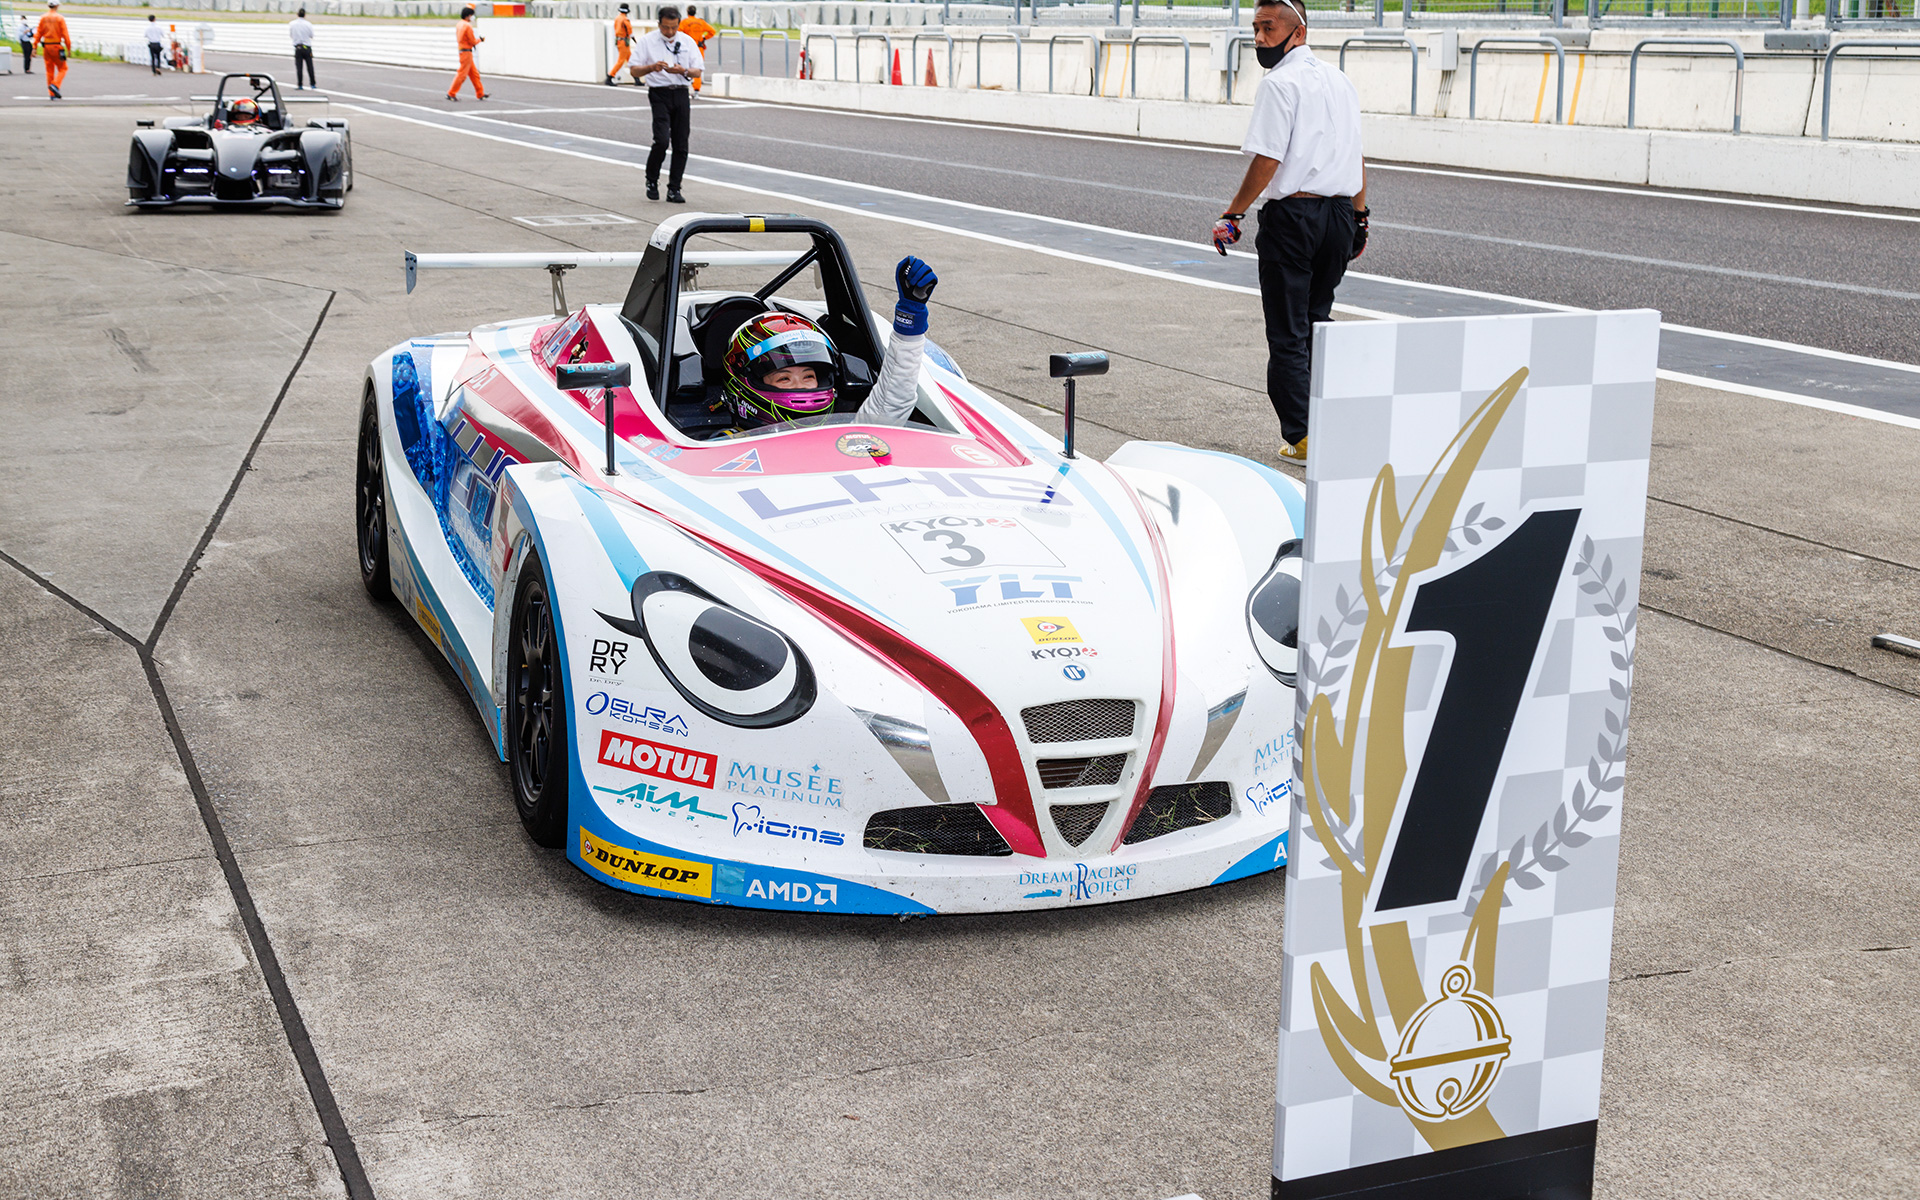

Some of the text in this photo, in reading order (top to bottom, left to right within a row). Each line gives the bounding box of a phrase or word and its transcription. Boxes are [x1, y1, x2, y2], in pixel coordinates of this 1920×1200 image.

[737, 471, 1074, 520] LHG
[922, 529, 986, 567] 3
[940, 574, 1083, 606] YLT
[947, 604, 992, 614] YOKOHAMA
[592, 639, 629, 659] DR
[589, 656, 627, 675] RY
[1374, 508, 1583, 912] 1
[602, 737, 711, 783] MOTUL
[1254, 728, 1295, 764] MUS
[727, 780, 841, 808] PLATINUM
[616, 798, 695, 822] POWER
[595, 847, 699, 884] DUNLOP
[1019, 863, 1137, 888] DREAM RACING
[746, 878, 812, 902] AMD
[1070, 877, 1133, 900] PROJECT
